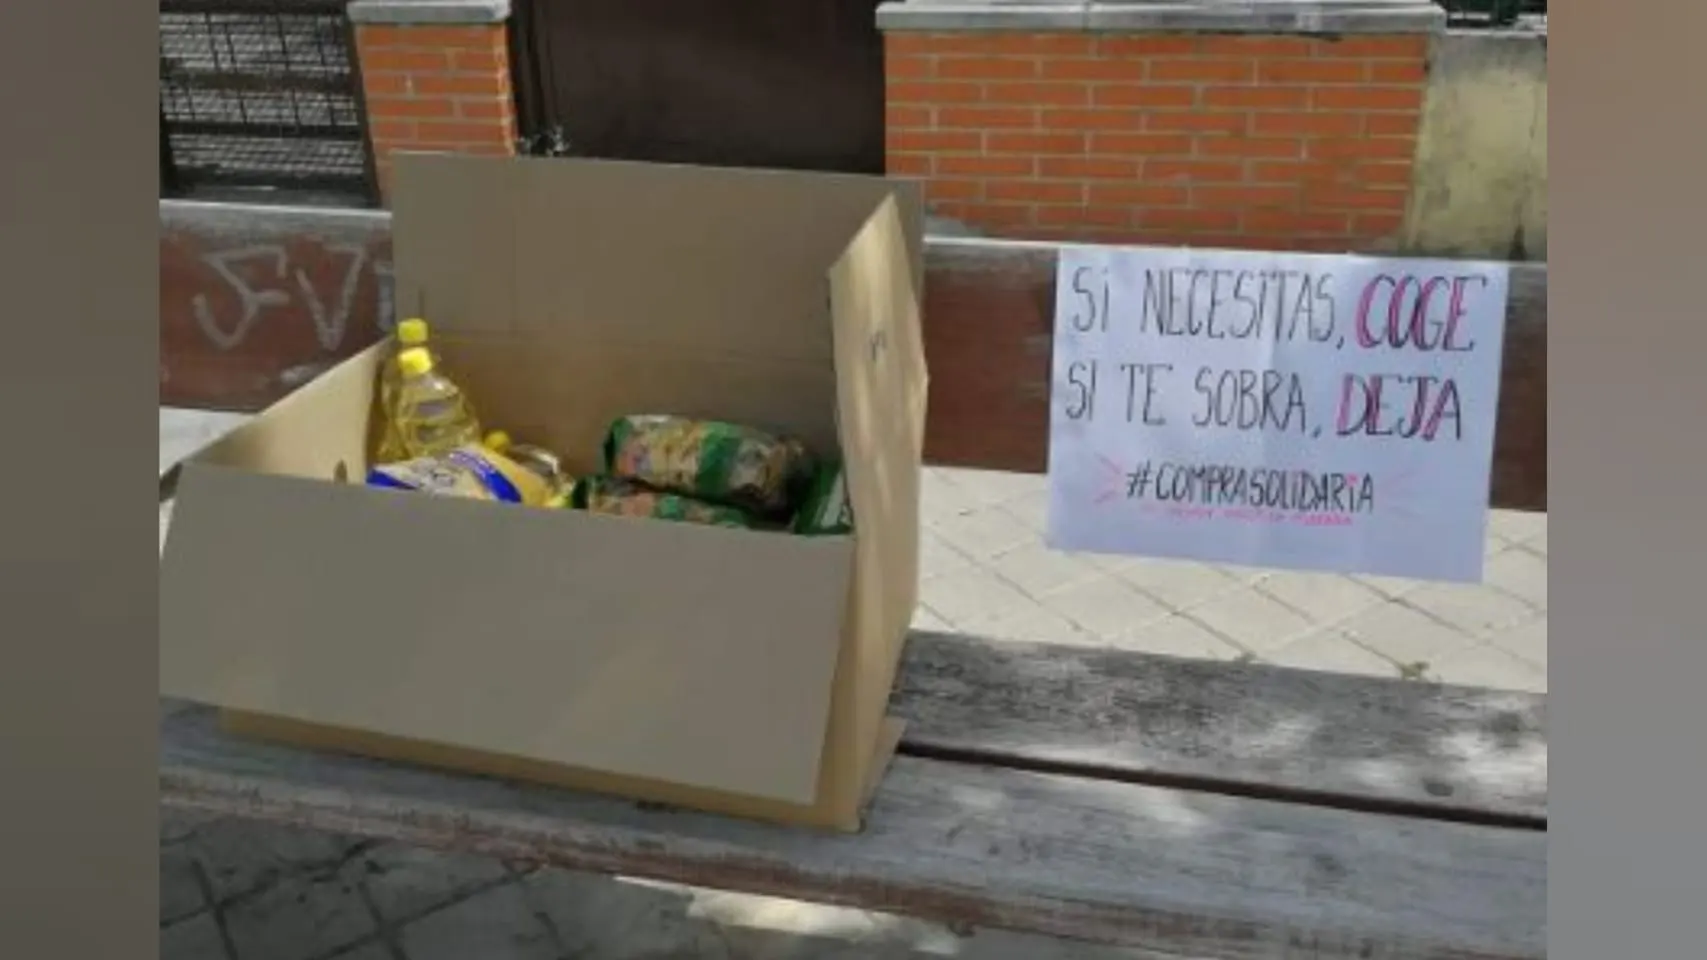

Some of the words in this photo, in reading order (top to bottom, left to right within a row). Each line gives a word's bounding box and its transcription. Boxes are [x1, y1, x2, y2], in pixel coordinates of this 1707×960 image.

[1356, 274, 1488, 351] COGE
[1066, 361, 1097, 421] SI
[1120, 363, 1173, 425] TE
[1191, 368, 1323, 438] SOBRA,
[1336, 373, 1463, 441] DEJA
